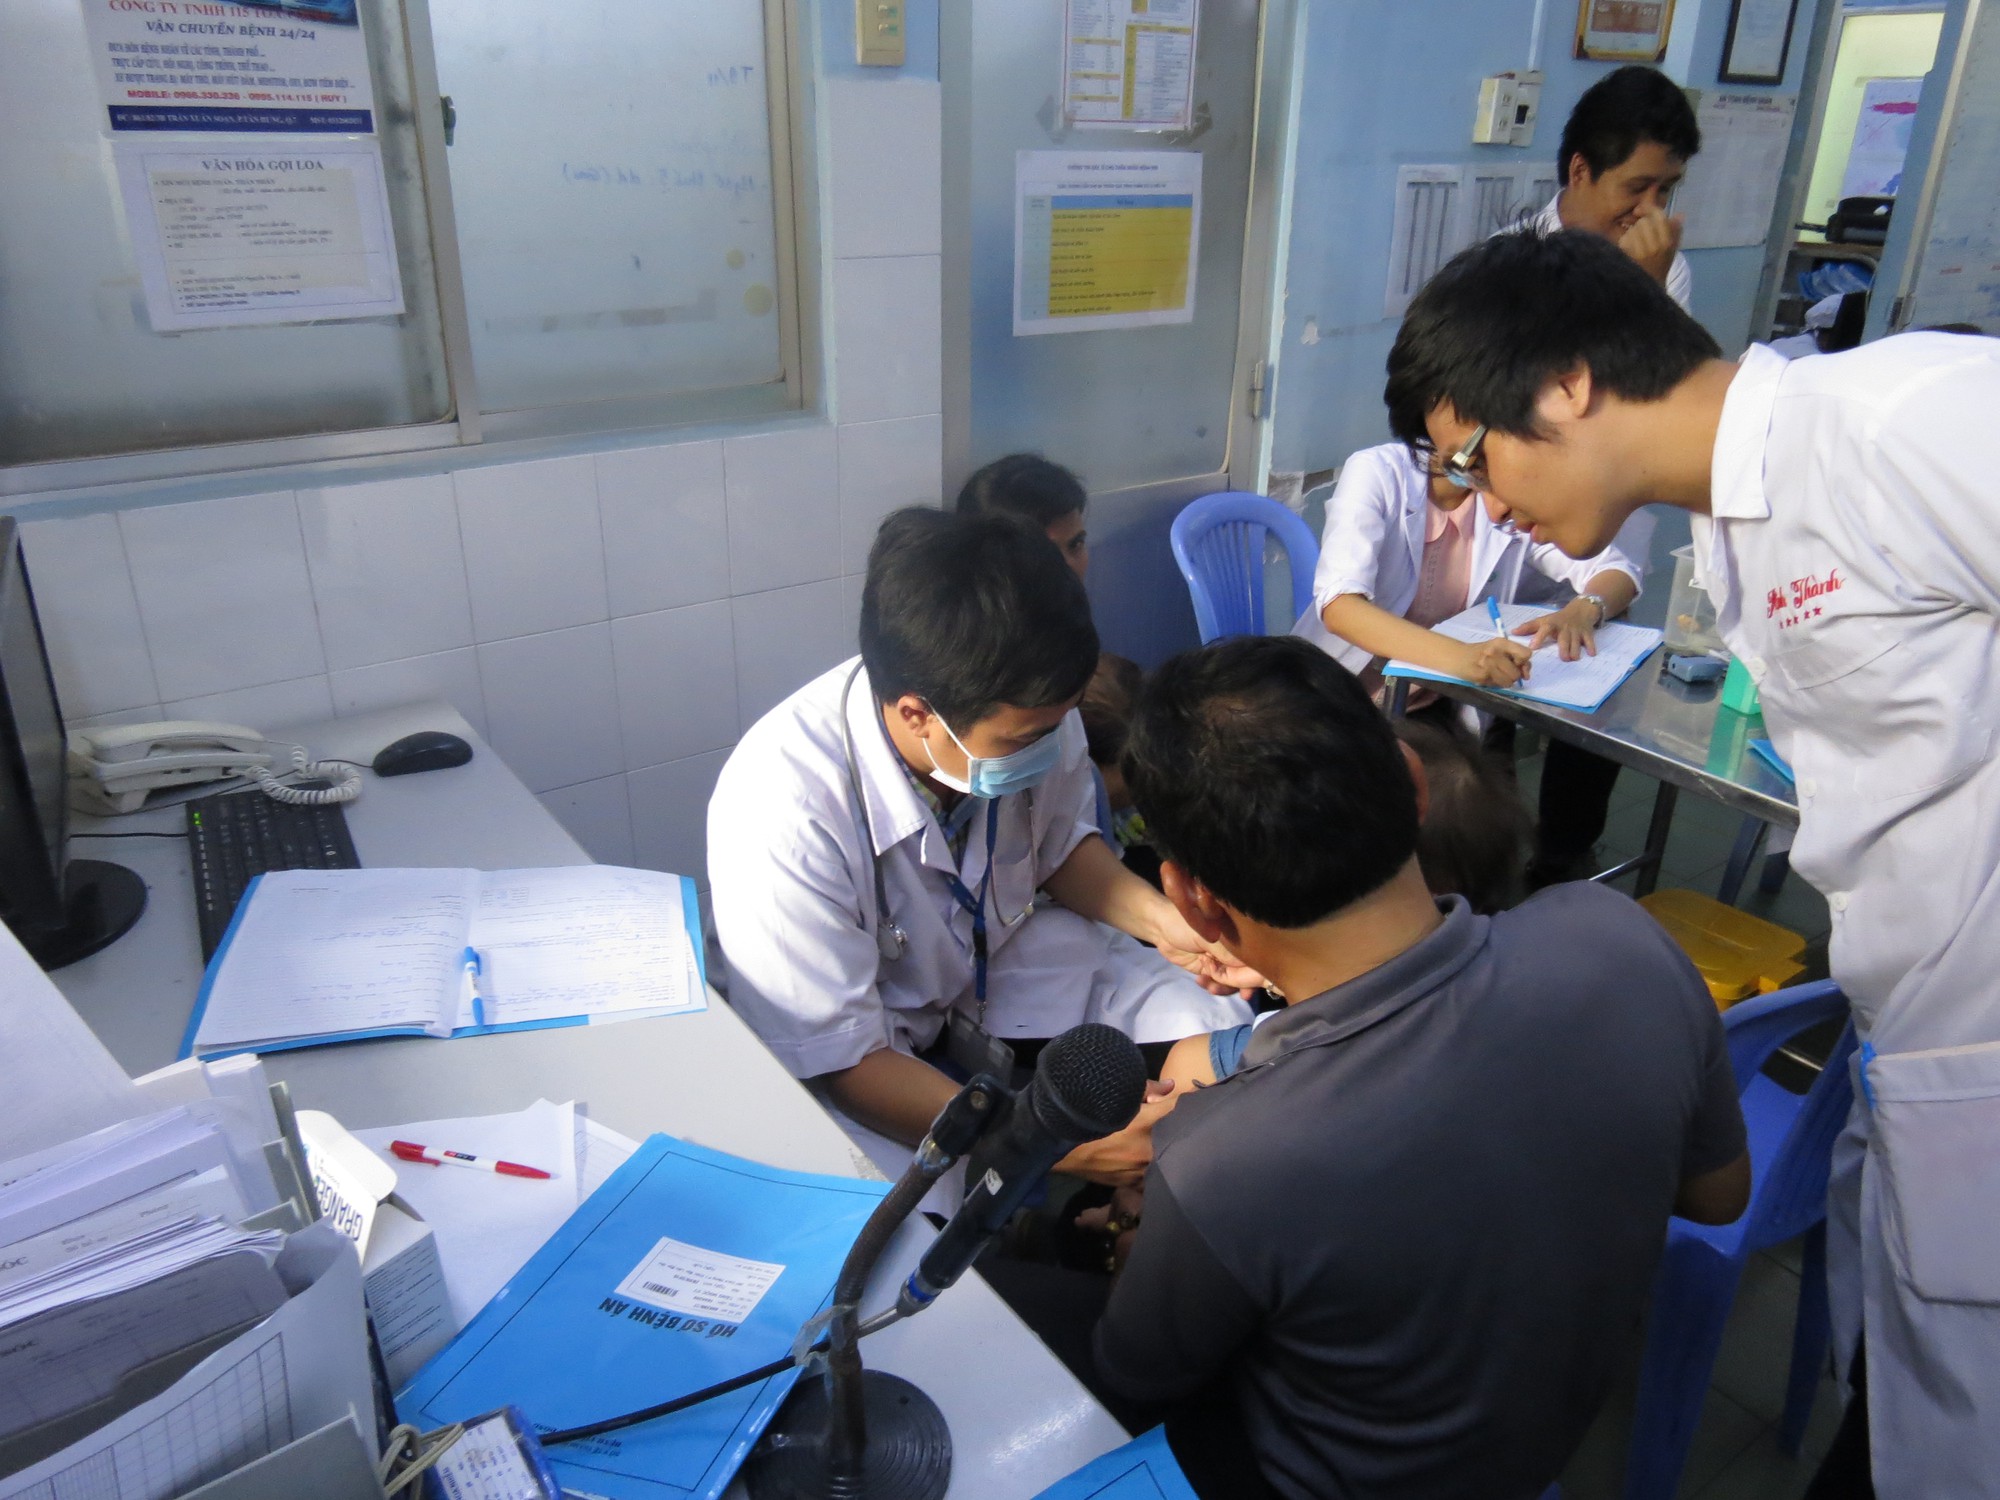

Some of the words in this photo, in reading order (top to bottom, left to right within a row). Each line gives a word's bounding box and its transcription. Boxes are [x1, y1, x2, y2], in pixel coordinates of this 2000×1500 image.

[239, 24, 276, 38] BỆNH
[202, 158, 232, 172] VĂN
[297, 159, 324, 171] LOA
[598, 1298, 630, 1318] ÁN
[626, 1307, 680, 1330] BỆNH
